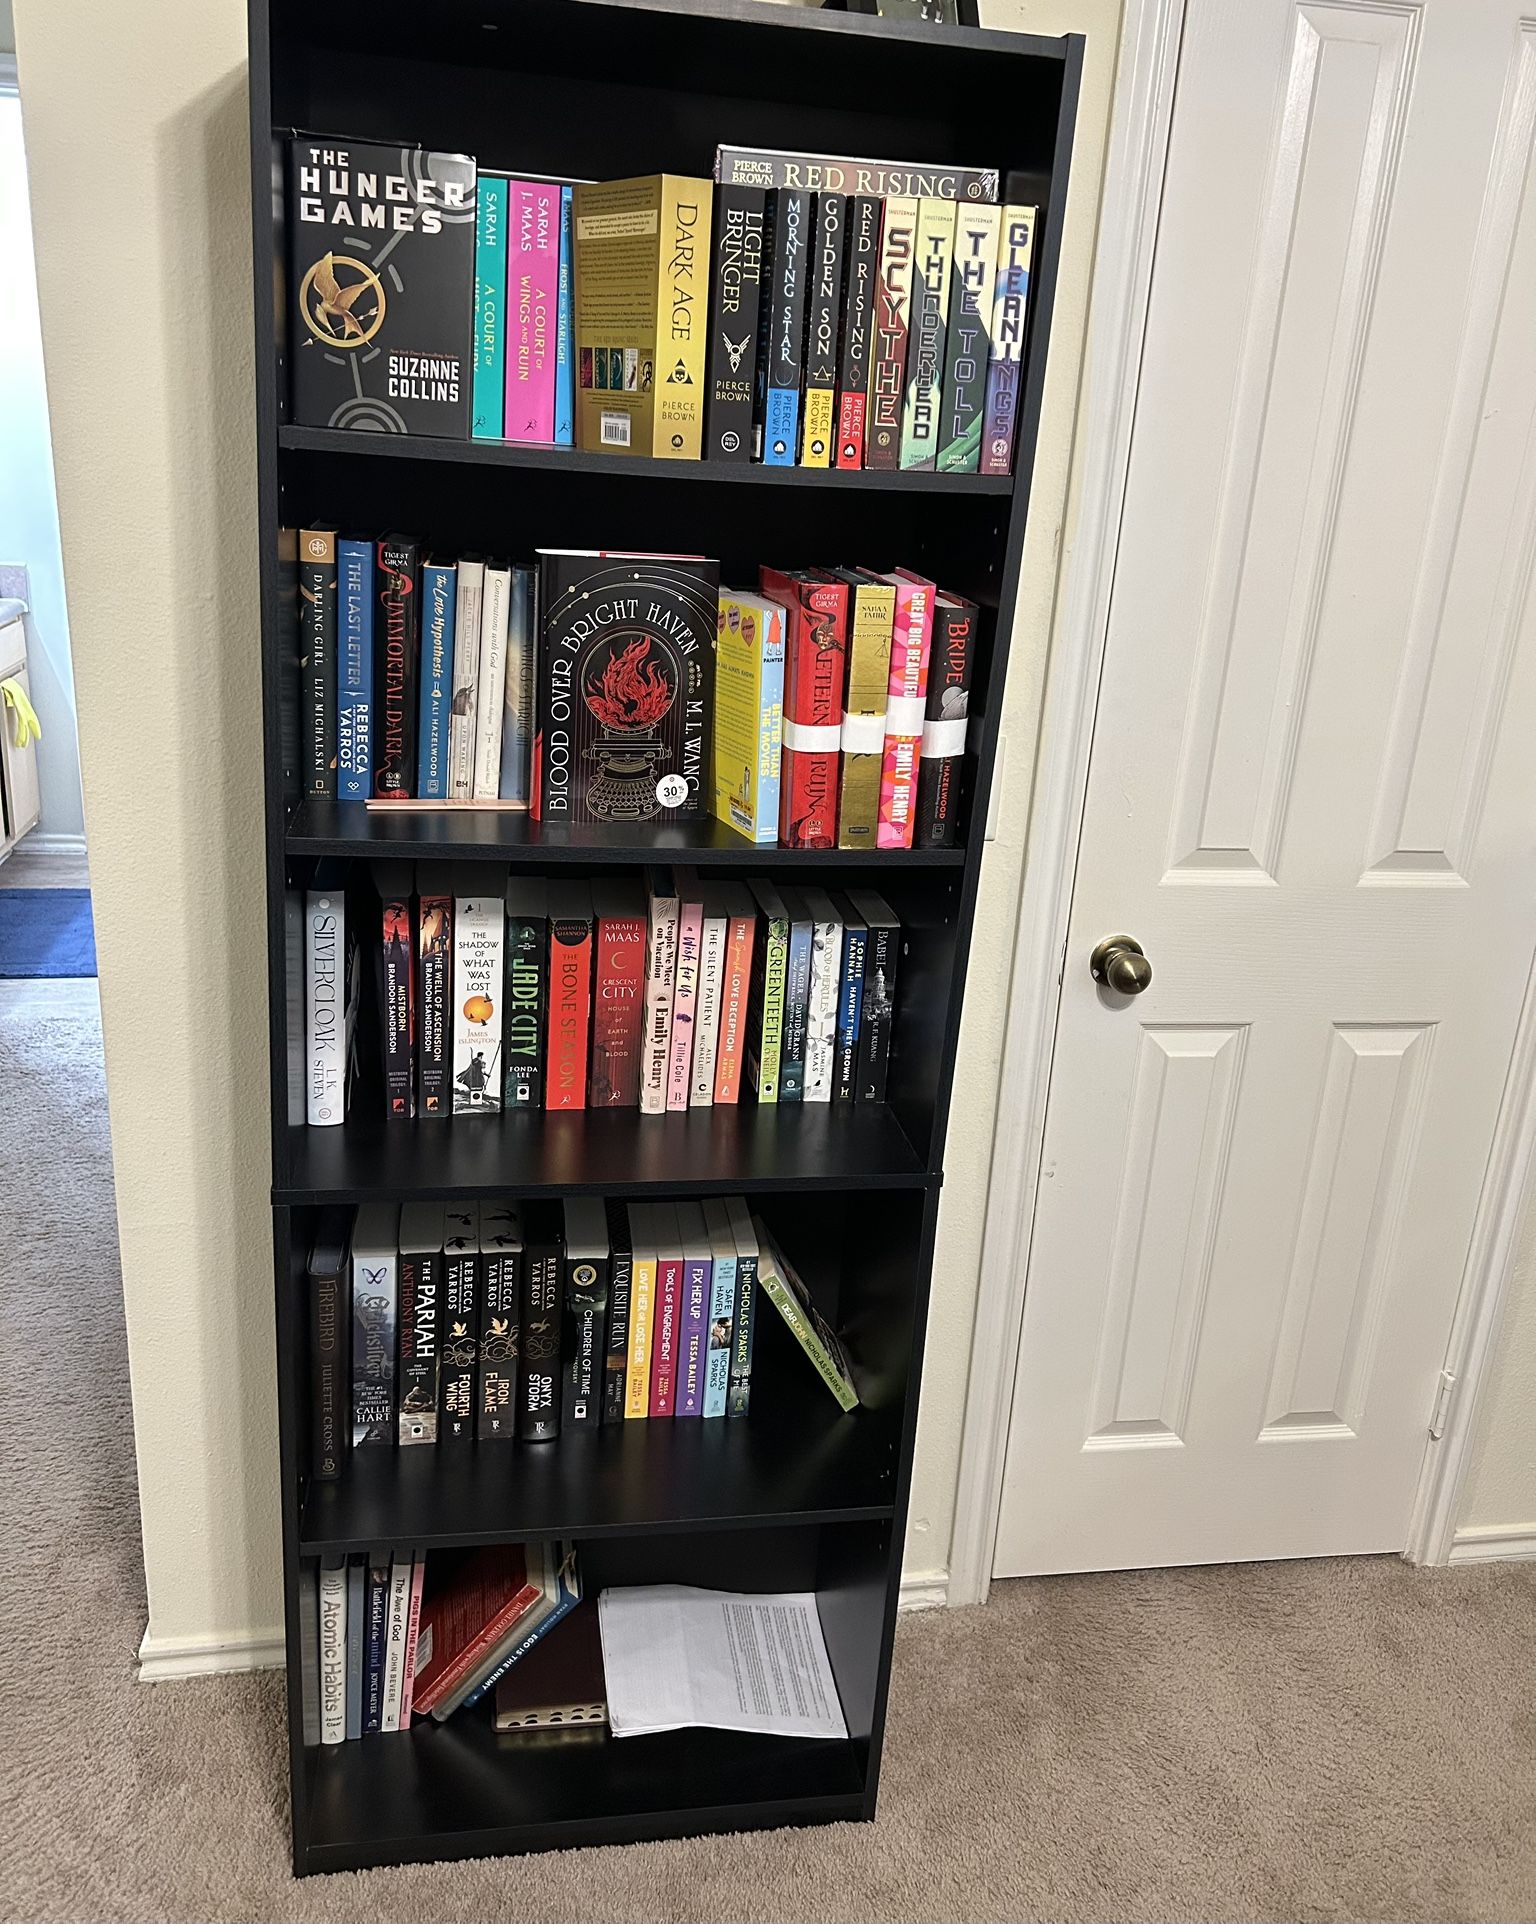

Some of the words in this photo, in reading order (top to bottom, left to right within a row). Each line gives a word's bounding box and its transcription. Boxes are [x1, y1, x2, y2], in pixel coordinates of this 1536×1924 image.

[310, 149, 348, 166] THE
[300, 166, 464, 207] HUNGER
[784, 163, 845, 190] RED
[855, 169, 957, 199] RISING
[300, 197, 443, 234] GAMES
[485, 192, 498, 246] SARAH
[888, 209, 916, 217] SHUSTERMAN
[964, 216, 993, 224] SHUSTERMAN
[668, 202, 698, 280] DARK
[743, 210, 763, 285] LIGHT
[783, 198, 804, 298] MORNING
[820, 199, 838, 298] GOLDEN
[720, 208, 744, 314] BRINGER
[484, 284, 496, 295] A
[535, 288, 547, 299] A
[560, 263, 569, 294] FROST
[519, 275, 531, 324] WINGS
[671, 285, 695, 341] AGE
[851, 262, 868, 359] RISING
[483, 301, 496, 354] COURT
[534, 305, 546, 357] COURT
[558, 313, 567, 364] STARLIGHT
[874, 227, 912, 428] SCYTHE
[388, 356, 460, 381] SUZANNE
[518, 345, 530, 381] RUIN
[388, 377, 459, 402] COLLINS
[662, 412, 695, 421] BROWN
[384, 551, 409, 560] TIGEST
[385, 559, 408, 567] GIRMA
[348, 563, 361, 591] THE
[313, 574, 324, 631] DARLING
[348, 595, 361, 632] LAST
[492, 578, 503, 631] Conversations
[815, 600, 838, 608] GIRMA
[560, 599, 639, 653] BRIGHT
[645, 602, 700, 656] HAVEN
[314, 637, 324, 666] GIRL
[348, 635, 361, 685] LETTER
[490, 650, 499, 669] God
[946, 617, 970, 684] BRIDE
[315, 678, 324, 698] LIZ
[551, 658, 573, 722] OVER
[431, 700, 440, 715] ALI
[315, 703, 324, 771] MICHALSKI
[340, 708, 352, 769] YARROS
[356, 704, 369, 774] REBECCA
[429, 718, 439, 777] HAZELWOOD
[549, 730, 570, 811] BLOOD
[895, 743, 914, 781] EMILY
[891, 785, 911, 824] HENRY
[458, 941, 500, 949] SHADOW
[604, 932, 640, 943] MAAS
[656, 927, 664, 939] on
[434, 952, 443, 967] THE
[462, 959, 496, 968] WHAT
[654, 940, 665, 979] Vacation
[799, 945, 807, 963] THE
[847, 937, 857, 982] HANNAH
[855, 941, 865, 978] SOPHIE
[312, 915, 337, 1051] SILVERCLOAK
[387, 963, 397, 1003] BRANDON
[424, 962, 433, 1003] BRANDON
[434, 967, 443, 995] WELL
[466, 982, 491, 992] LOST
[467, 971, 491, 980] WAS
[512, 958, 539, 1010] JADE
[603, 978, 637, 986] CRESCENT
[796, 963, 806, 994] WAGER
[397, 985, 407, 1032] MISTBORN
[434, 996, 443, 1009] OF
[602, 986, 637, 999] CITY
[765, 946, 784, 1044] GREENTEETH
[388, 1004, 397, 1054] SANDERSON
[424, 1003, 433, 1052] SANDERSON
[467, 1028, 488, 1037] JAMES
[650, 1007, 669, 1046] Emily
[794, 1004, 803, 1029] DAVID
[433, 1010, 442, 1062] ASCENSION
[458, 1037, 497, 1045] ISLINGTON
[511, 1014, 538, 1057] CITY
[792, 1029, 801, 1061] GRANN
[647, 1049, 666, 1091] Henry
[697, 1034, 706, 1079] MICHAELIDES
[812, 1052, 820, 1072] MAS
[819, 1047, 827, 1077] JASMINE
[313, 1060, 324, 1100] STEVEN
[422, 1260, 431, 1281] THE
[665, 1267, 676, 1292] TOOLS
[447, 1266, 459, 1310] YARROS
[463, 1261, 474, 1313] REBECCA
[714, 1285, 724, 1316] HAVEN
[724, 1288, 733, 1310] SAFE
[739, 1273, 752, 1326] NICHOLAS
[414, 1284, 436, 1358] PARIAH
[661, 1305, 673, 1361] ENGAGEMENT
[689, 1334, 699, 1362] TESSA
[737, 1329, 749, 1363] SPARKS
[687, 1364, 697, 1395] BAILEY
[709, 1358, 719, 1388] SPARKS
[718, 1351, 728, 1391] NICHOLAS
[741, 1378, 750, 1394] BEST
[742, 1364, 750, 1378] THE
[445, 1381, 459, 1411] WING
[457, 1374, 471, 1417] FOURTH
[484, 1372, 498, 1413] FLAME
[497, 1379, 510, 1405] IRON
[527, 1373, 541, 1412] STORM
[540, 1376, 553, 1408] ONYX
[614, 1374, 623, 1402] ADRIANNE
[356, 1405, 391, 1415] CALLIE
[357, 1412, 391, 1423] HART
[411, 1595, 420, 1618] PIGS
[556, 1603, 568, 1616] RYAN
[323, 1601, 342, 1659] Atomic
[410, 1629, 418, 1645] THE
[411, 1619, 418, 1628] IN
[539, 1614, 557, 1634] HOLIDAY
[515, 1647, 523, 1657] IS
[522, 1632, 539, 1650] EGO
[388, 1652, 398, 1673] JOHN
[406, 1646, 416, 1679] PARLOR
[502, 1654, 518, 1671] THE
[323, 1661, 343, 1712] Habits
[370, 1673, 378, 1695] JOYCE
[388, 1673, 397, 1703] BEVERE
[481, 1667, 505, 1691] ENEMY
[370, 1695, 378, 1714] MEYER
